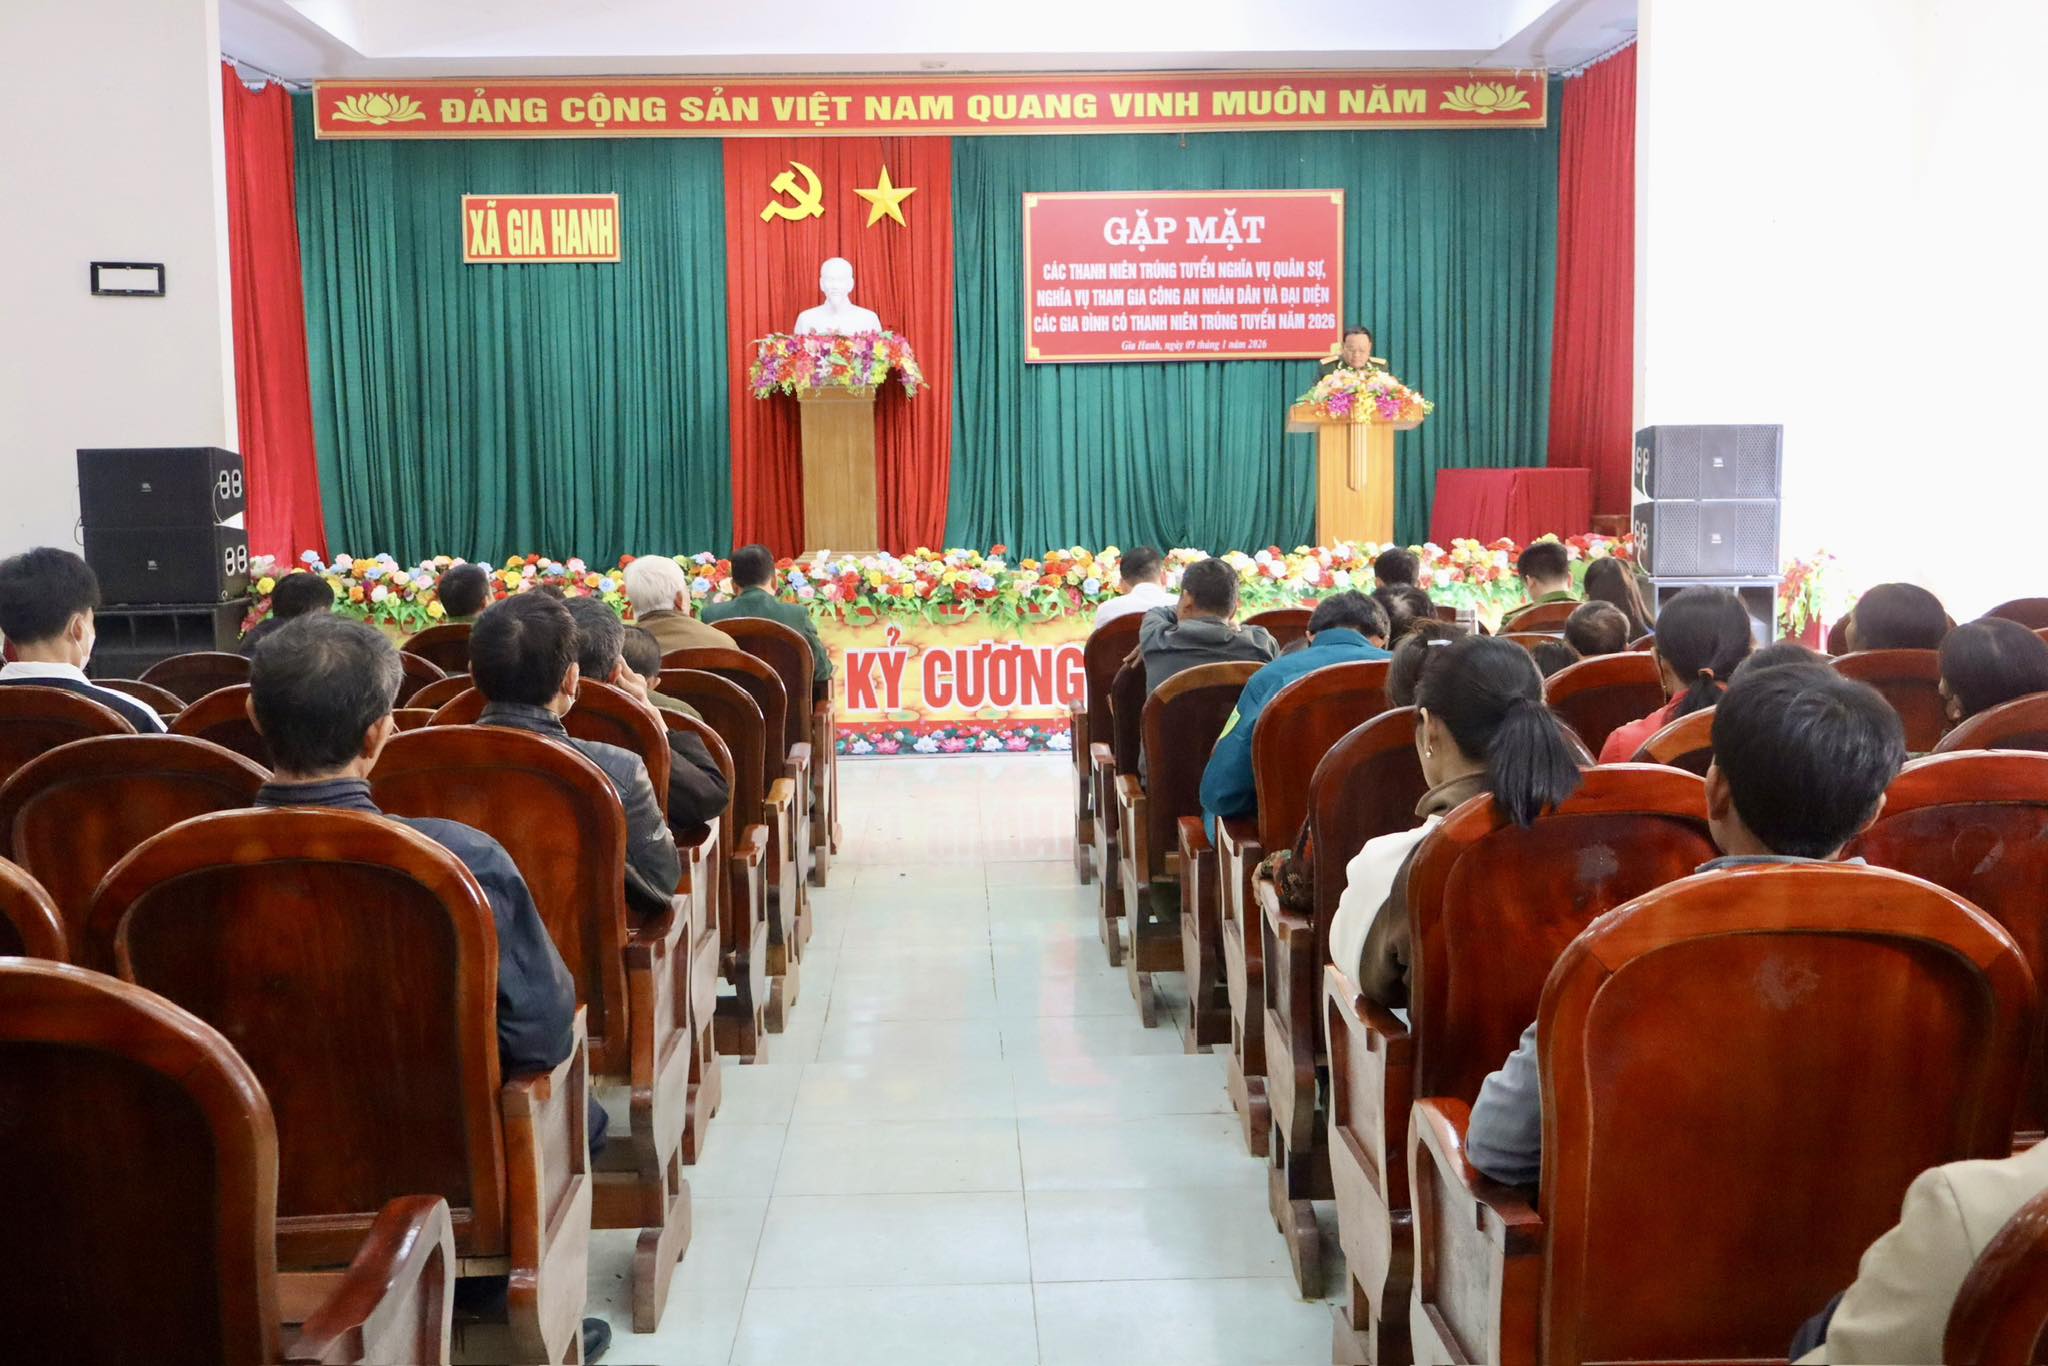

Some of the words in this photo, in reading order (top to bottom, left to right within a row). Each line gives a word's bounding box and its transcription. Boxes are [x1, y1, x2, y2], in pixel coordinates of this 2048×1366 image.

[440, 88, 548, 123] ĐẢNG
[561, 92, 667, 127] CỘNG
[680, 86, 759, 121] SẢN
[771, 91, 852, 126] VIỆT
[864, 95, 954, 120] NAM
[967, 93, 1097, 122] QUANG
[1109, 92, 1199, 118] VINH
[1212, 85, 1326, 116] MUÔN
[1339, 83, 1427, 114] NĂM
[469, 200, 502, 256] XÃ
[507, 208, 546, 256] GIA
[551, 208, 614, 256] HANH
[1103, 208, 1177, 252] GẶP
[1185, 207, 1265, 252] MẶT
[1043, 260, 1067, 280] CÁC
[1069, 262, 1107, 280] THANH
[1109, 259, 1137, 279] NIÊN
[1139, 259, 1177, 279] TRÚNG
[1179, 255, 1216, 279] TUYỂN
[1218, 258, 1253, 278] NGHĨA
[1255, 261, 1271, 281] VỤ
[1273, 257, 1304, 279] QUÂN
[1307, 259, 1326, 280] SỰ,
[1036, 286, 1072, 307] NGHĨA
[1074, 289, 1090, 310] VỤ
[1092, 288, 1124, 306] THAM
[1127, 288, 1147, 306] GIA
[1149, 285, 1180, 305] CÔNG
[1183, 287, 1199, 305] AN
[1202, 284, 1234, 305] NHÂN
[1237, 284, 1260, 304] DÂN
[1263, 283, 1278, 304] VÀ
[1280, 287, 1300, 307] ĐẠI
[1303, 283, 1329, 307] DIỆN
[1033, 313, 1057, 332] CÁC
[1059, 315, 1079, 332] GIA
[1081, 312, 1110, 332] ĐÌNH
[1112, 312, 1128, 331] CÓ
[1130, 314, 1168, 331] THANH
[1170, 311, 1197, 331] NIÊN
[1200, 311, 1238, 330] TRÚNG
[1240, 307, 1276, 330] TUYỂN
[1279, 310, 1305, 329] NĂM
[1307, 313, 1336, 329] 2026
[1121, 340, 1136, 351] Gia
[1164, 340, 1184, 352] ngày
[1185, 340, 1196, 350] 09
[1197, 340, 1220, 352] tháng
[1228, 340, 1246, 350] năm
[1247, 339, 1268, 350] 2026
[846, 625, 907, 710] KỶ
[923, 642, 1085, 709] CƯƠNG
